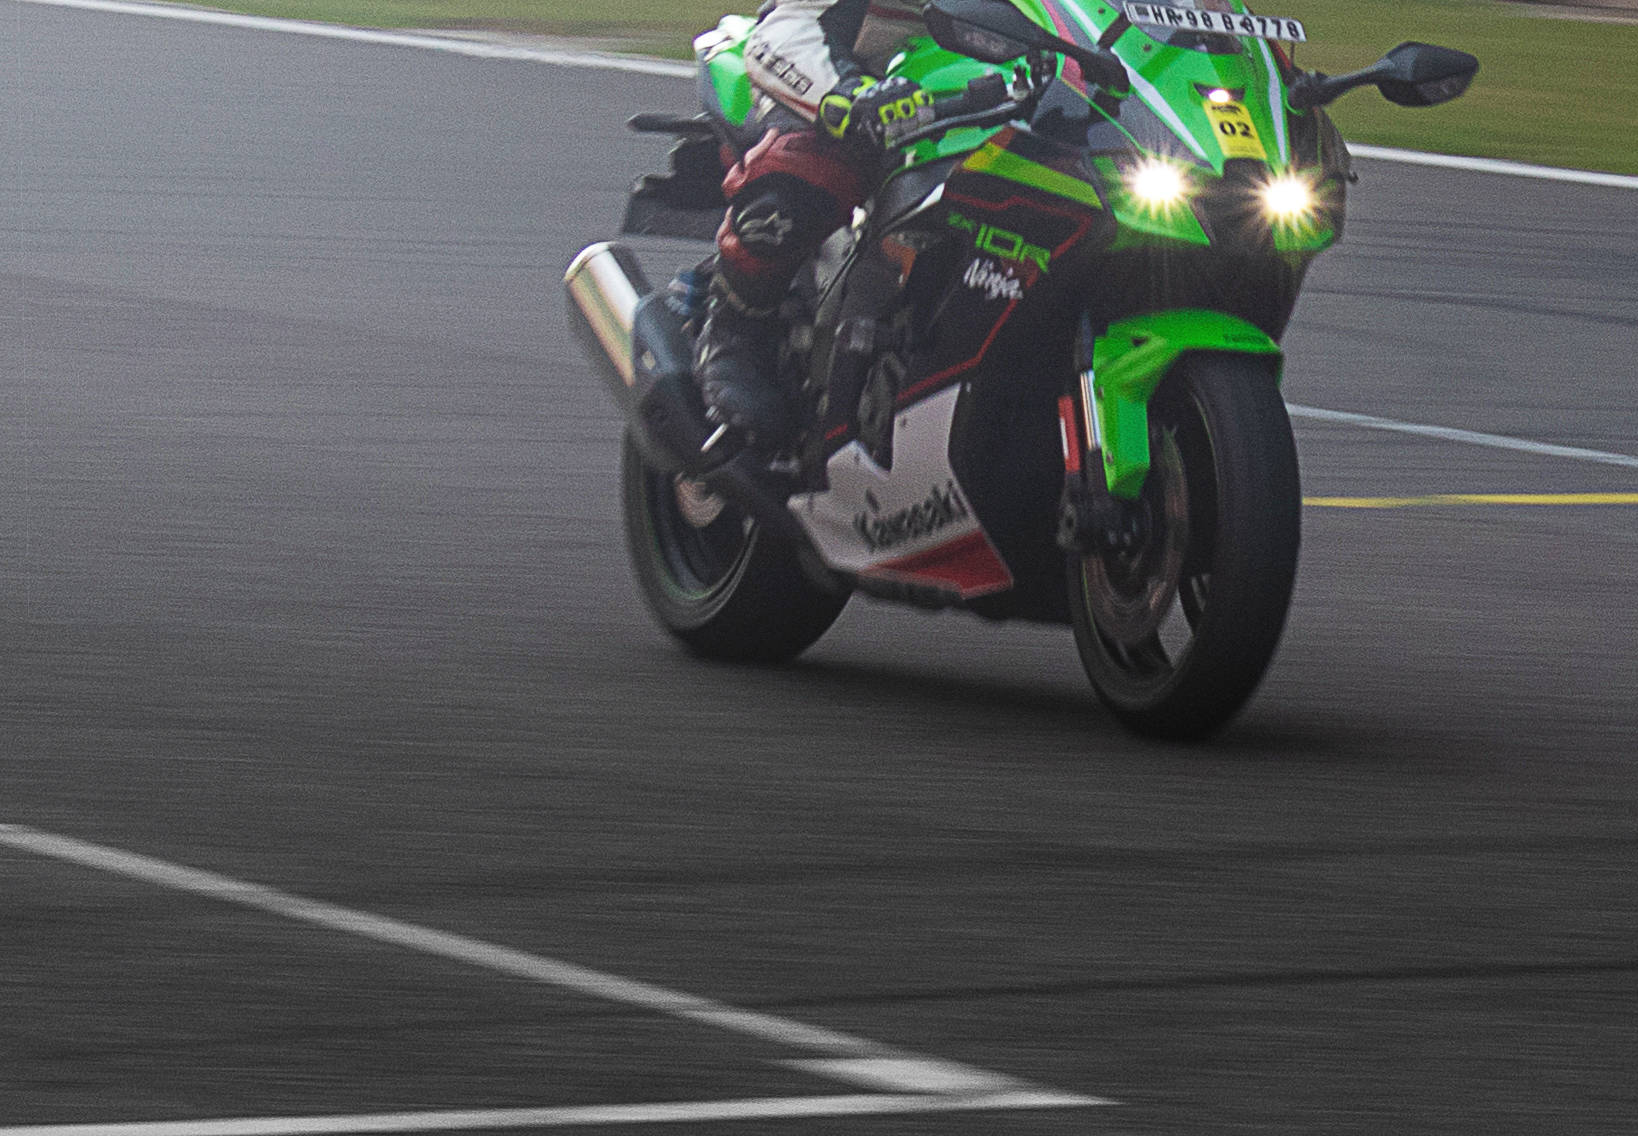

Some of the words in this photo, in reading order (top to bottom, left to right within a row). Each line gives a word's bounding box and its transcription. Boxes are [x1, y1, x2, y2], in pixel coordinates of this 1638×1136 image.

[1151, 5, 1180, 26] HR
[1219, 120, 1255, 139] 02
[853, 479, 969, 554] Kawasaki
